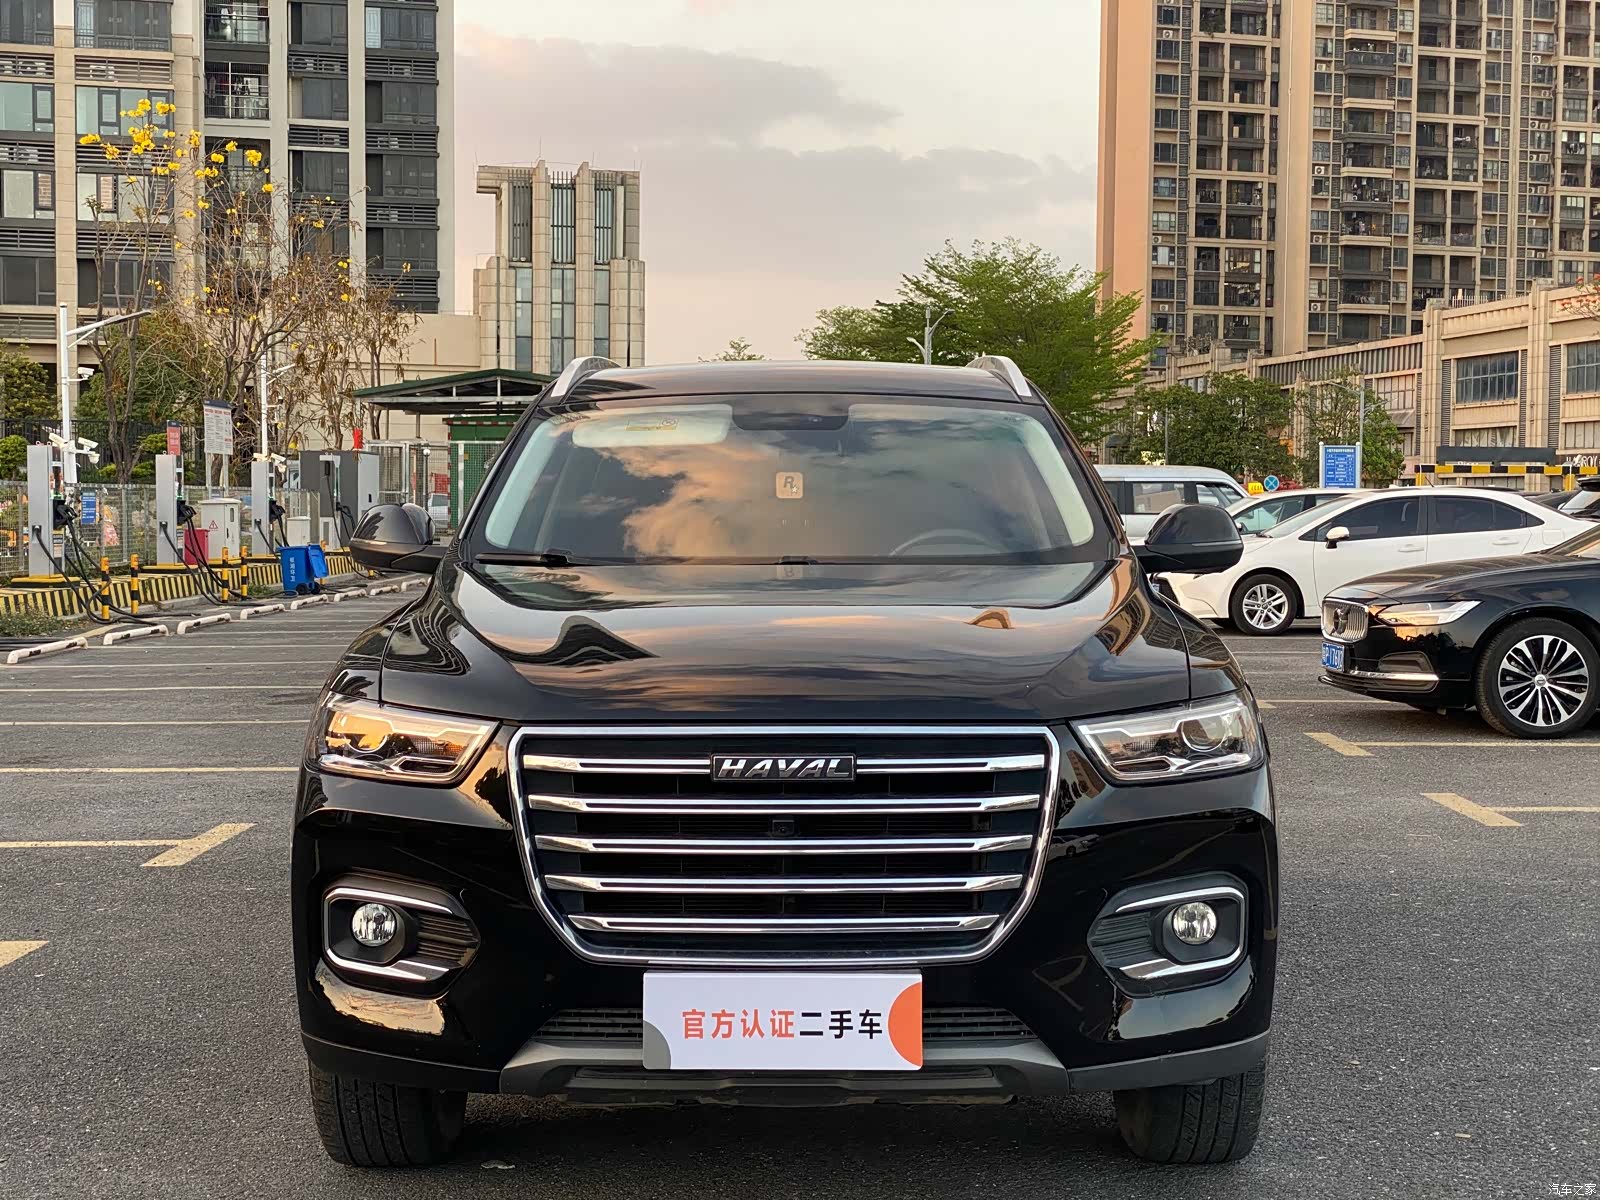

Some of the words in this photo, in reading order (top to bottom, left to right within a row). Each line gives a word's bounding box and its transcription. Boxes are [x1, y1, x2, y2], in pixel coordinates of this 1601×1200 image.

[718, 759, 849, 777] HAVAL
[682, 1009, 883, 1039] 官方认证二手车
